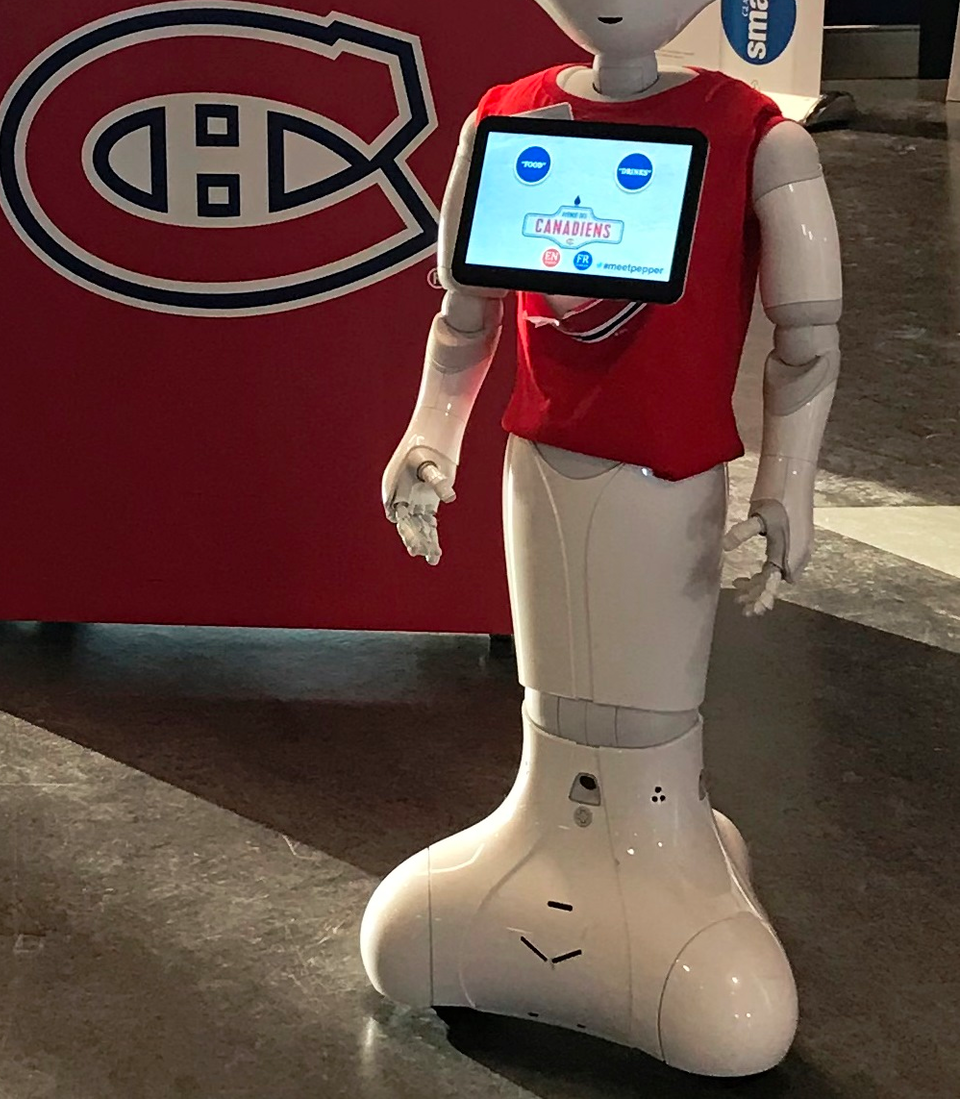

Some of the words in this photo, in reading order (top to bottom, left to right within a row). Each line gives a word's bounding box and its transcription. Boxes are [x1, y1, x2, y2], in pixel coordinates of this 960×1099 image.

[534, 218, 612, 239] CANADIENS
[544, 252, 558, 261] EN
[576, 254, 590, 265] FR
[603, 263, 664, 275] #meetpepper
